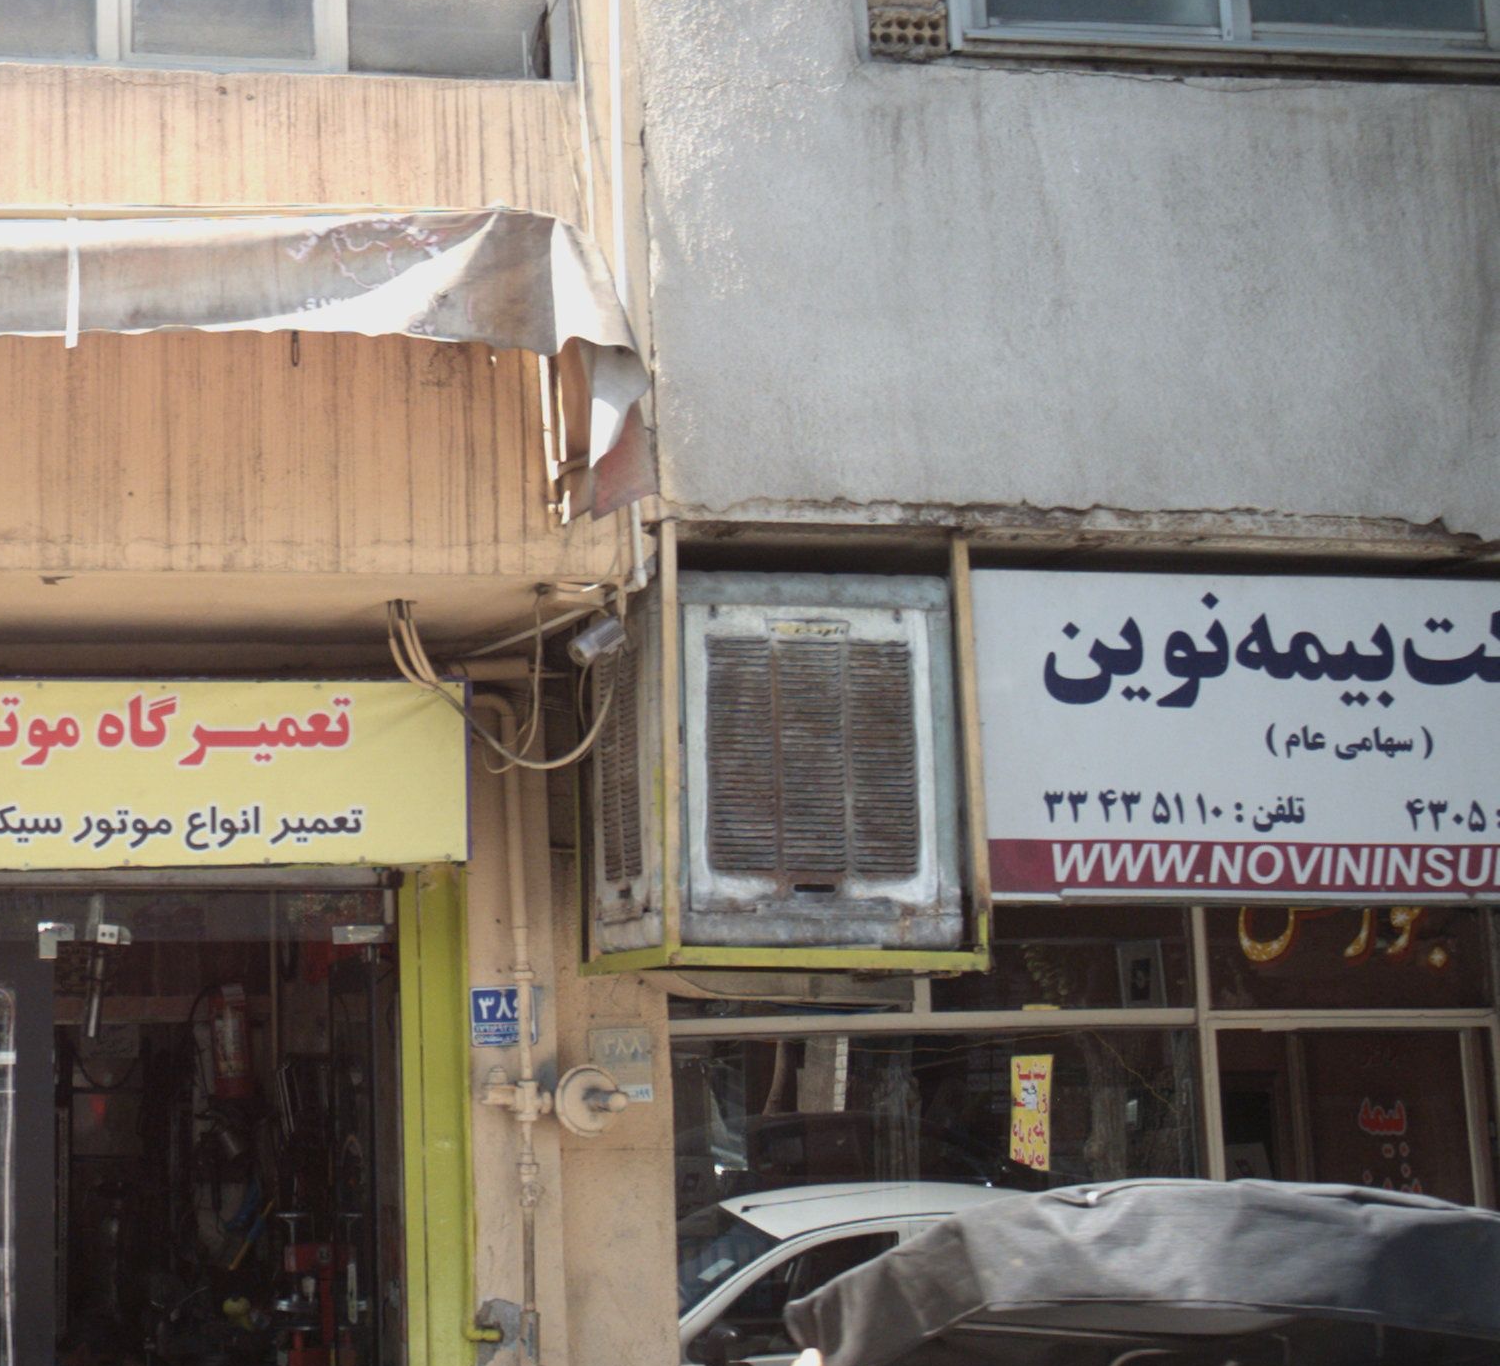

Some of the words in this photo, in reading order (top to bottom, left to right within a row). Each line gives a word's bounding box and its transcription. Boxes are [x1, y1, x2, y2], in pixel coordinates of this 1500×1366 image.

[1043, 591, 1230, 708] نوین
[1235, 612, 1395, 708] بیمه
[72, 809, 173, 849] موتور
[185, 805, 261, 851] انواع
[270, 808, 364, 845] تعمیر
[1050, 841, 1500, 889] WWW.NOVININSU
[478, 996, 520, 1020] ۳۸
